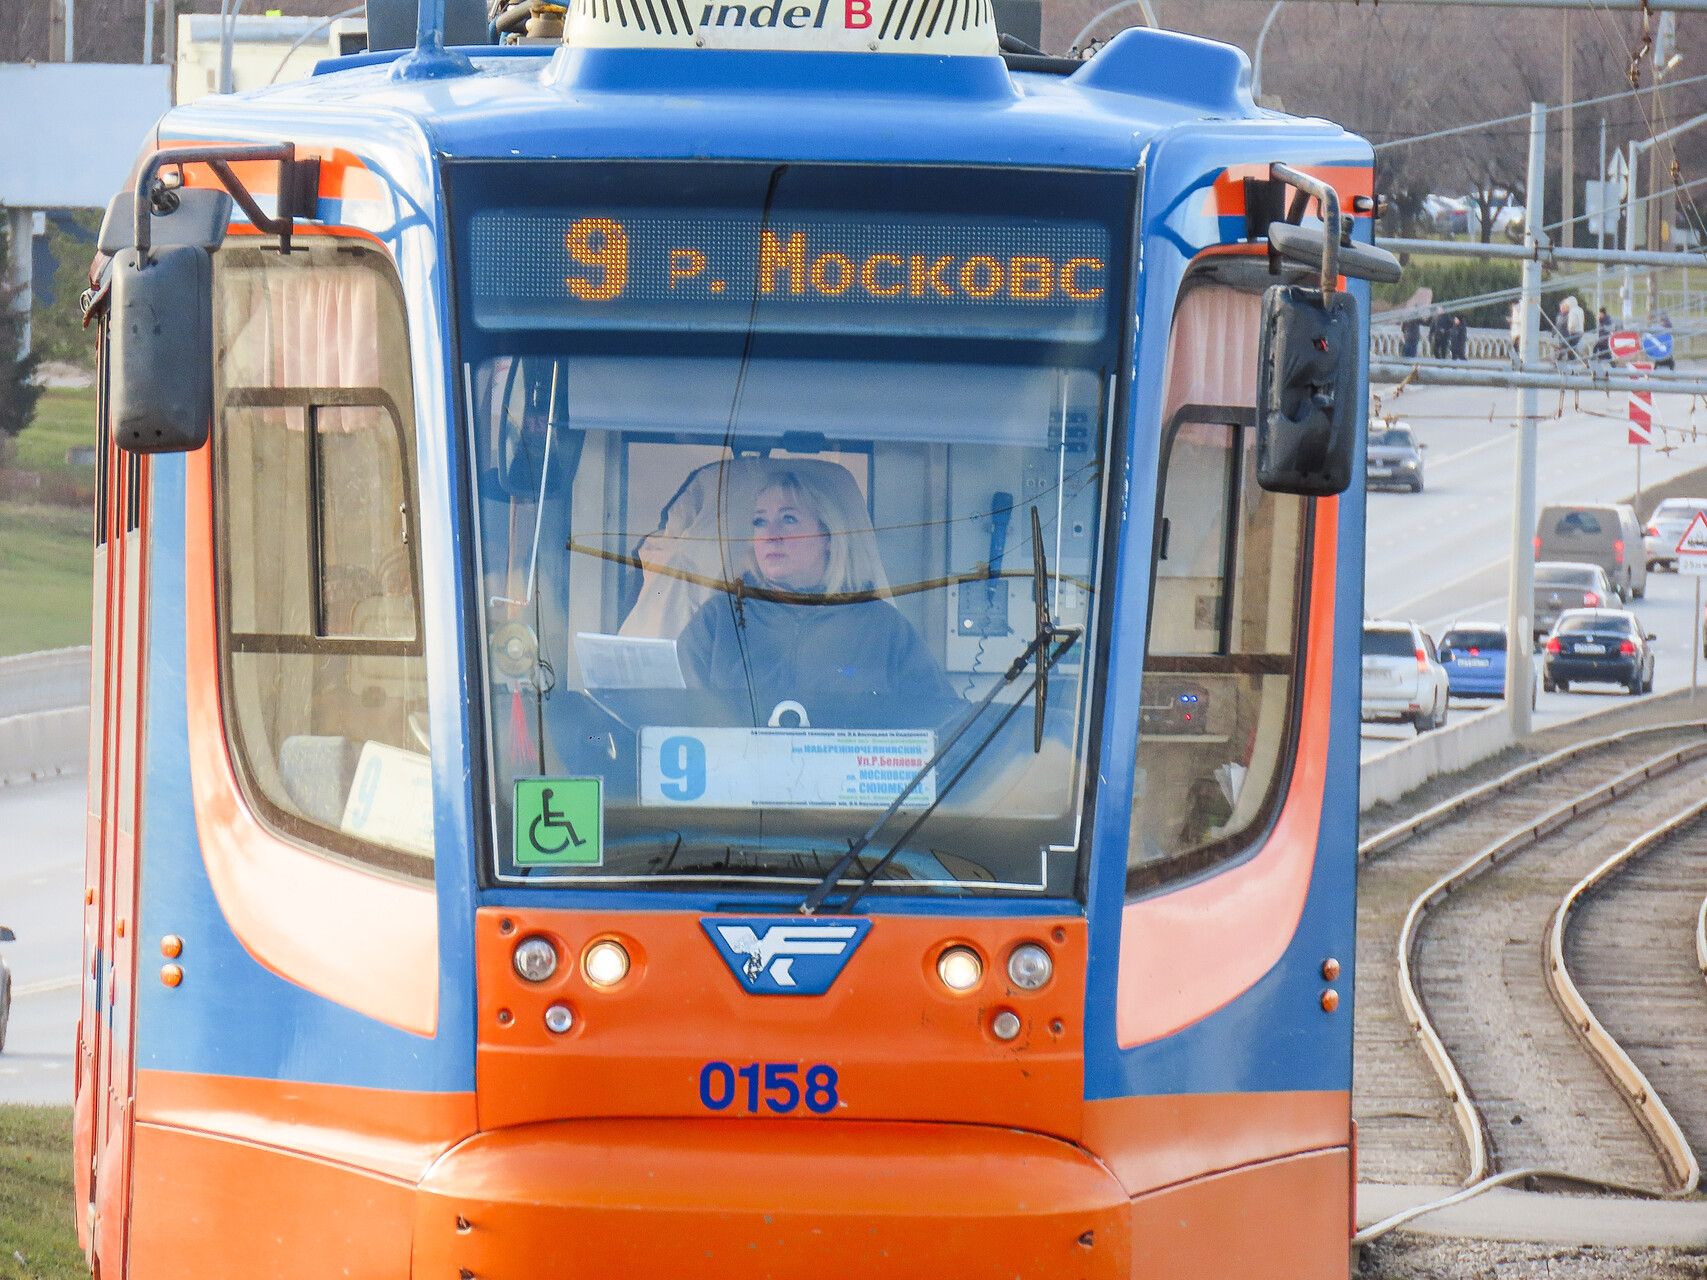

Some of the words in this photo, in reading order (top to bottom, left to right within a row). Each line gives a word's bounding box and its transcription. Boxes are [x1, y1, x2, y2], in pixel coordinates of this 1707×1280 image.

[699, 0, 829, 28] indel
[844, 0, 872, 29] B
[565, 217, 628, 300] 9
[760, 229, 1104, 300] Московс
[660, 735, 707, 802] 9
[699, 1060, 839, 1114] 0158
